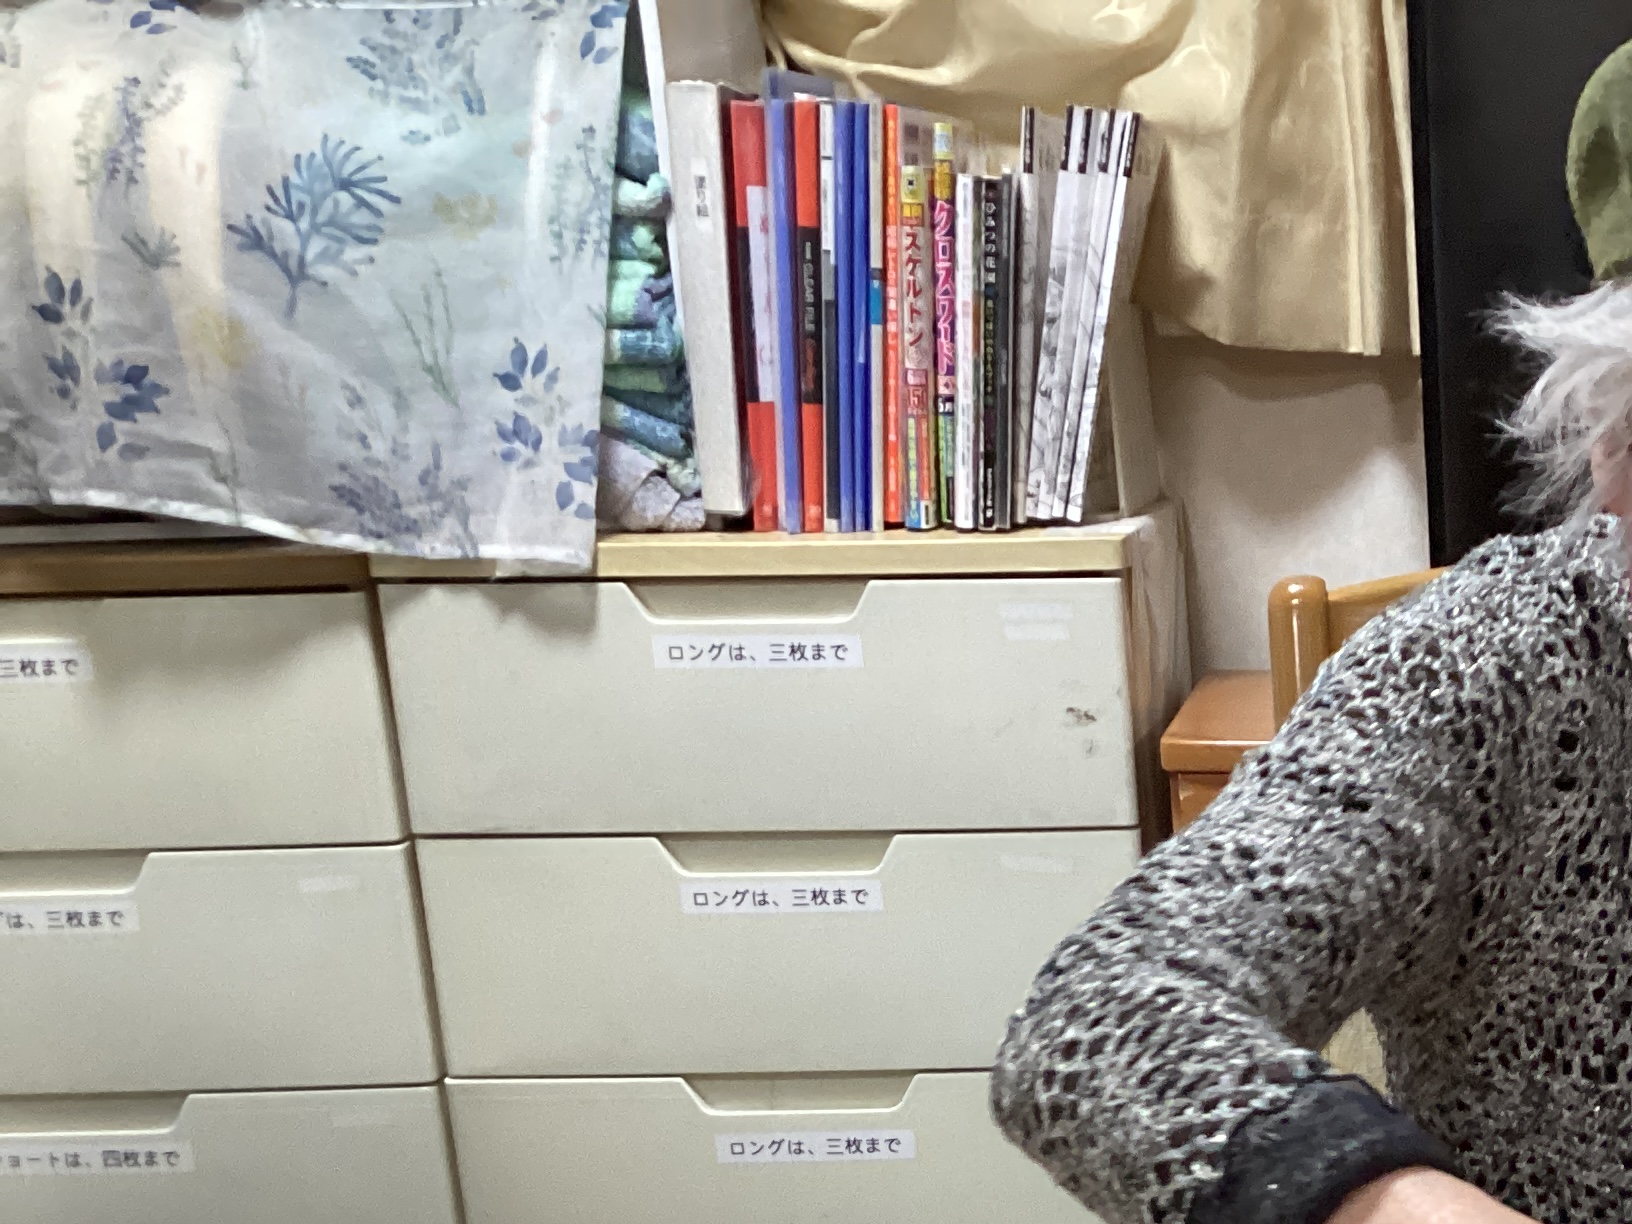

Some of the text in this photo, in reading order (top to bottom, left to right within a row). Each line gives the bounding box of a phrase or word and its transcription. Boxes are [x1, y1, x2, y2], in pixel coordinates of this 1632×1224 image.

[904, 230, 925, 347] スケルトン
[934, 200, 956, 376] クロスワード
[667, 643, 849, 663] ロングは、三枚まで
[692, 887, 870, 907] ロングは、三枚まで
[729, 1136, 902, 1157] ロングは、三枚まで
